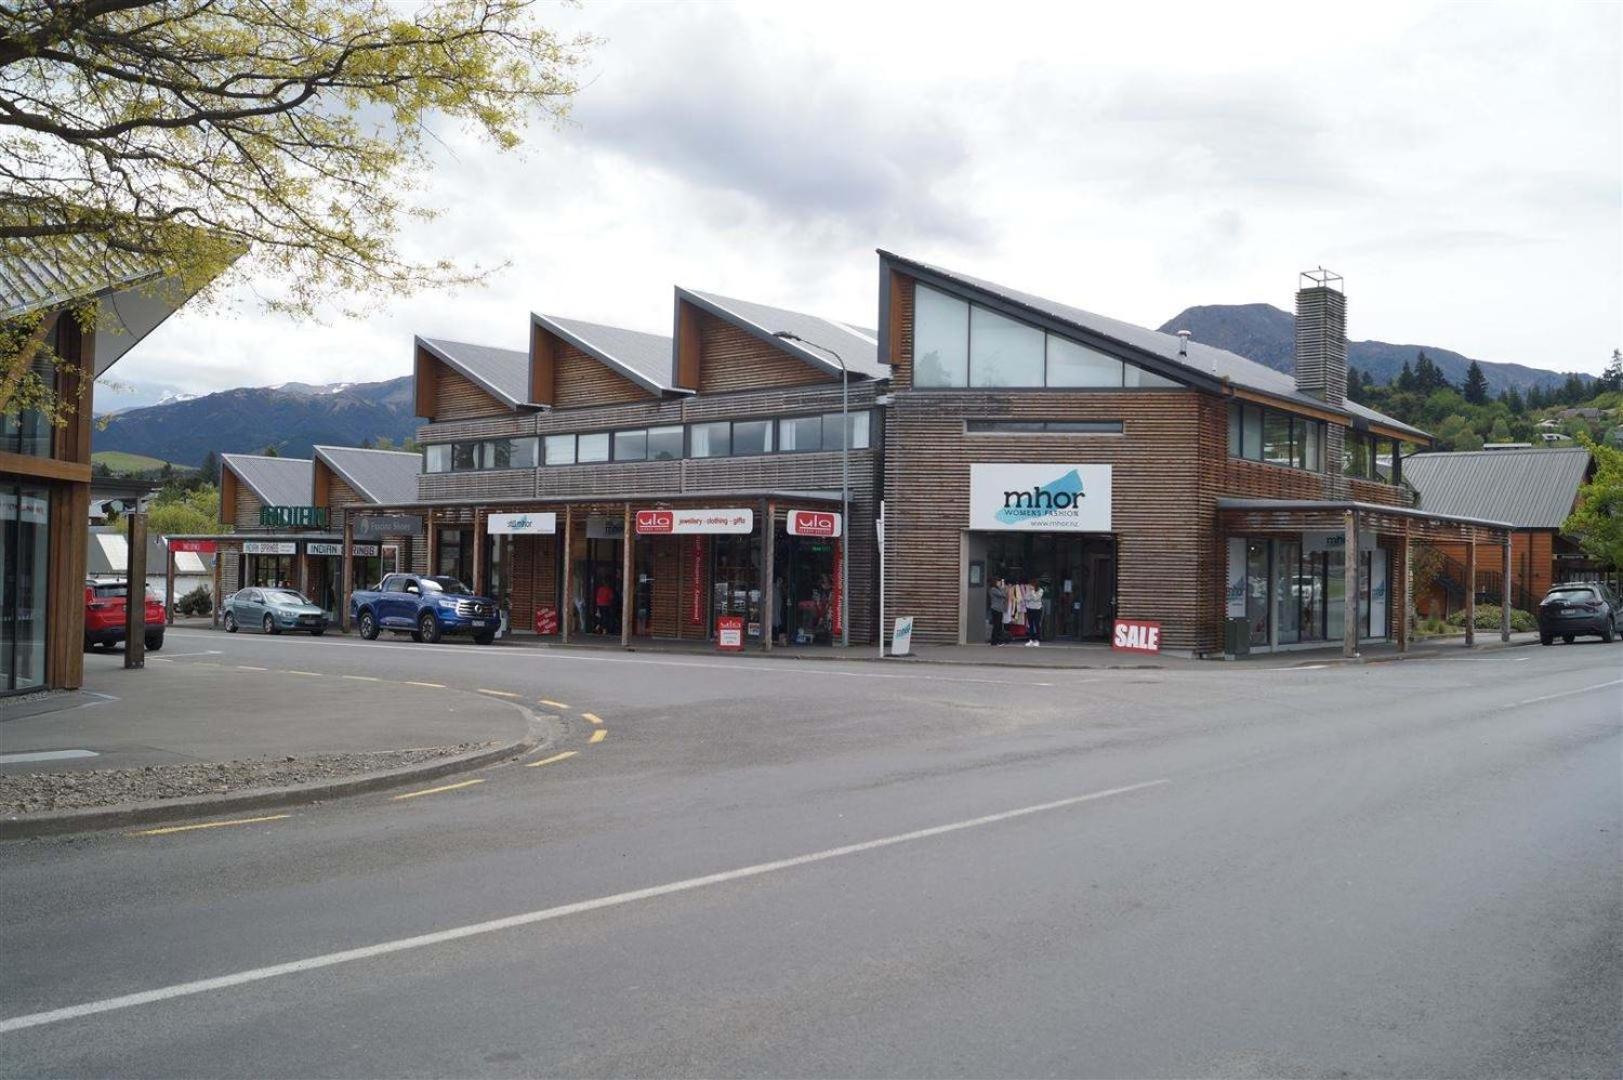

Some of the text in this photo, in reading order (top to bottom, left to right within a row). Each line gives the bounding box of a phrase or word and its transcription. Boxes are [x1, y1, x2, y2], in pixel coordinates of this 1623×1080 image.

[1003, 486, 1086, 509] mhor
[1004, 509, 1079, 517] WOMENS FASHION
[639, 513, 670, 526] ula
[706, 516, 728, 526] clothing
[732, 515, 746, 526] gifts
[799, 514, 832, 528] ula
[1030, 520, 1079, 528] www.mhor.nz
[310, 543, 338, 554] INDIAN
[1114, 623, 1159, 650] SALE
